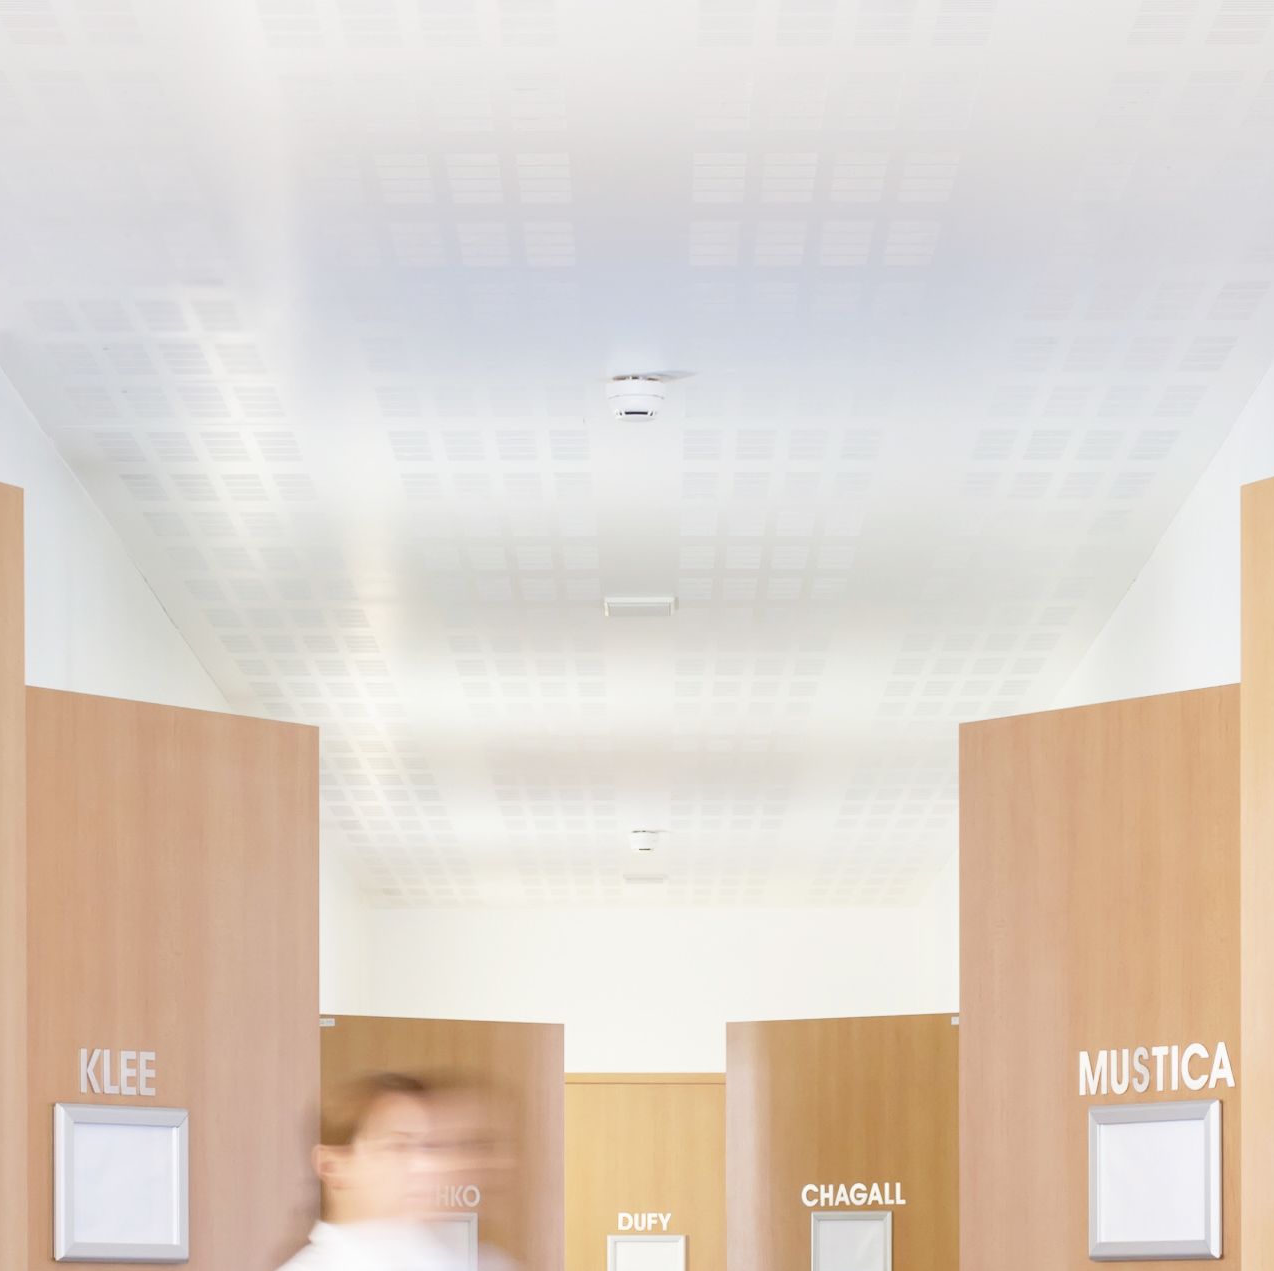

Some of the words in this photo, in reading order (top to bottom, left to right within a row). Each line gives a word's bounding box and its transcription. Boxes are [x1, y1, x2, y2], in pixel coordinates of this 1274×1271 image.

[80, 1047, 156, 1096] KLEE
[1078, 1041, 1236, 1096] MUSTICA
[801, 1181, 907, 1208] CHAGALL
[617, 1212, 672, 1232] DUFY
